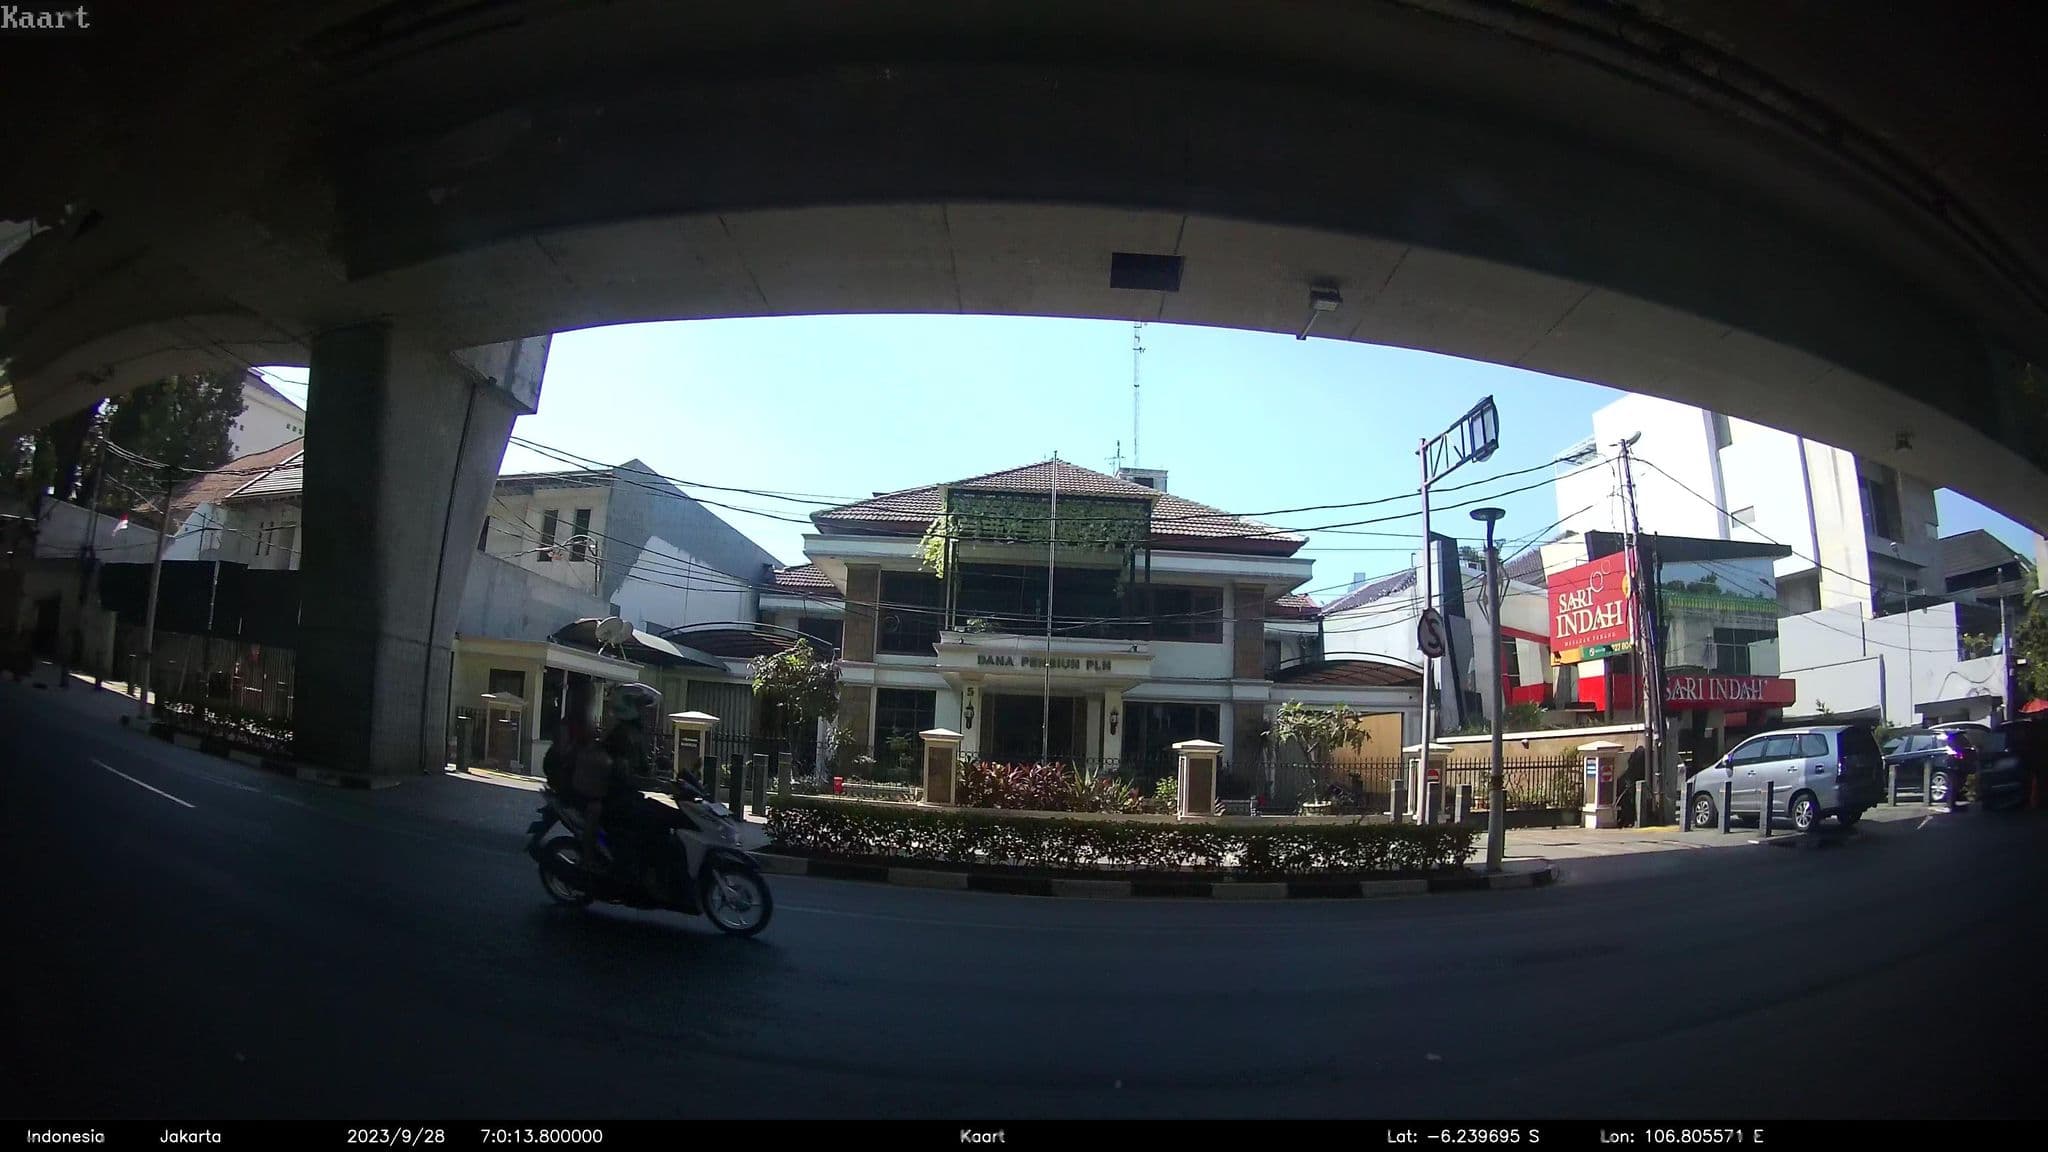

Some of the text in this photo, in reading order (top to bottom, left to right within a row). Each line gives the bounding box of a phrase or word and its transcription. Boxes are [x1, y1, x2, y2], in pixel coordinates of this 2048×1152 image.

[1558, 587, 1594, 614] SARI
[1556, 600, 1624, 638] INDAH
[977, 655, 1111, 671] DANA PENSIUN PLN
